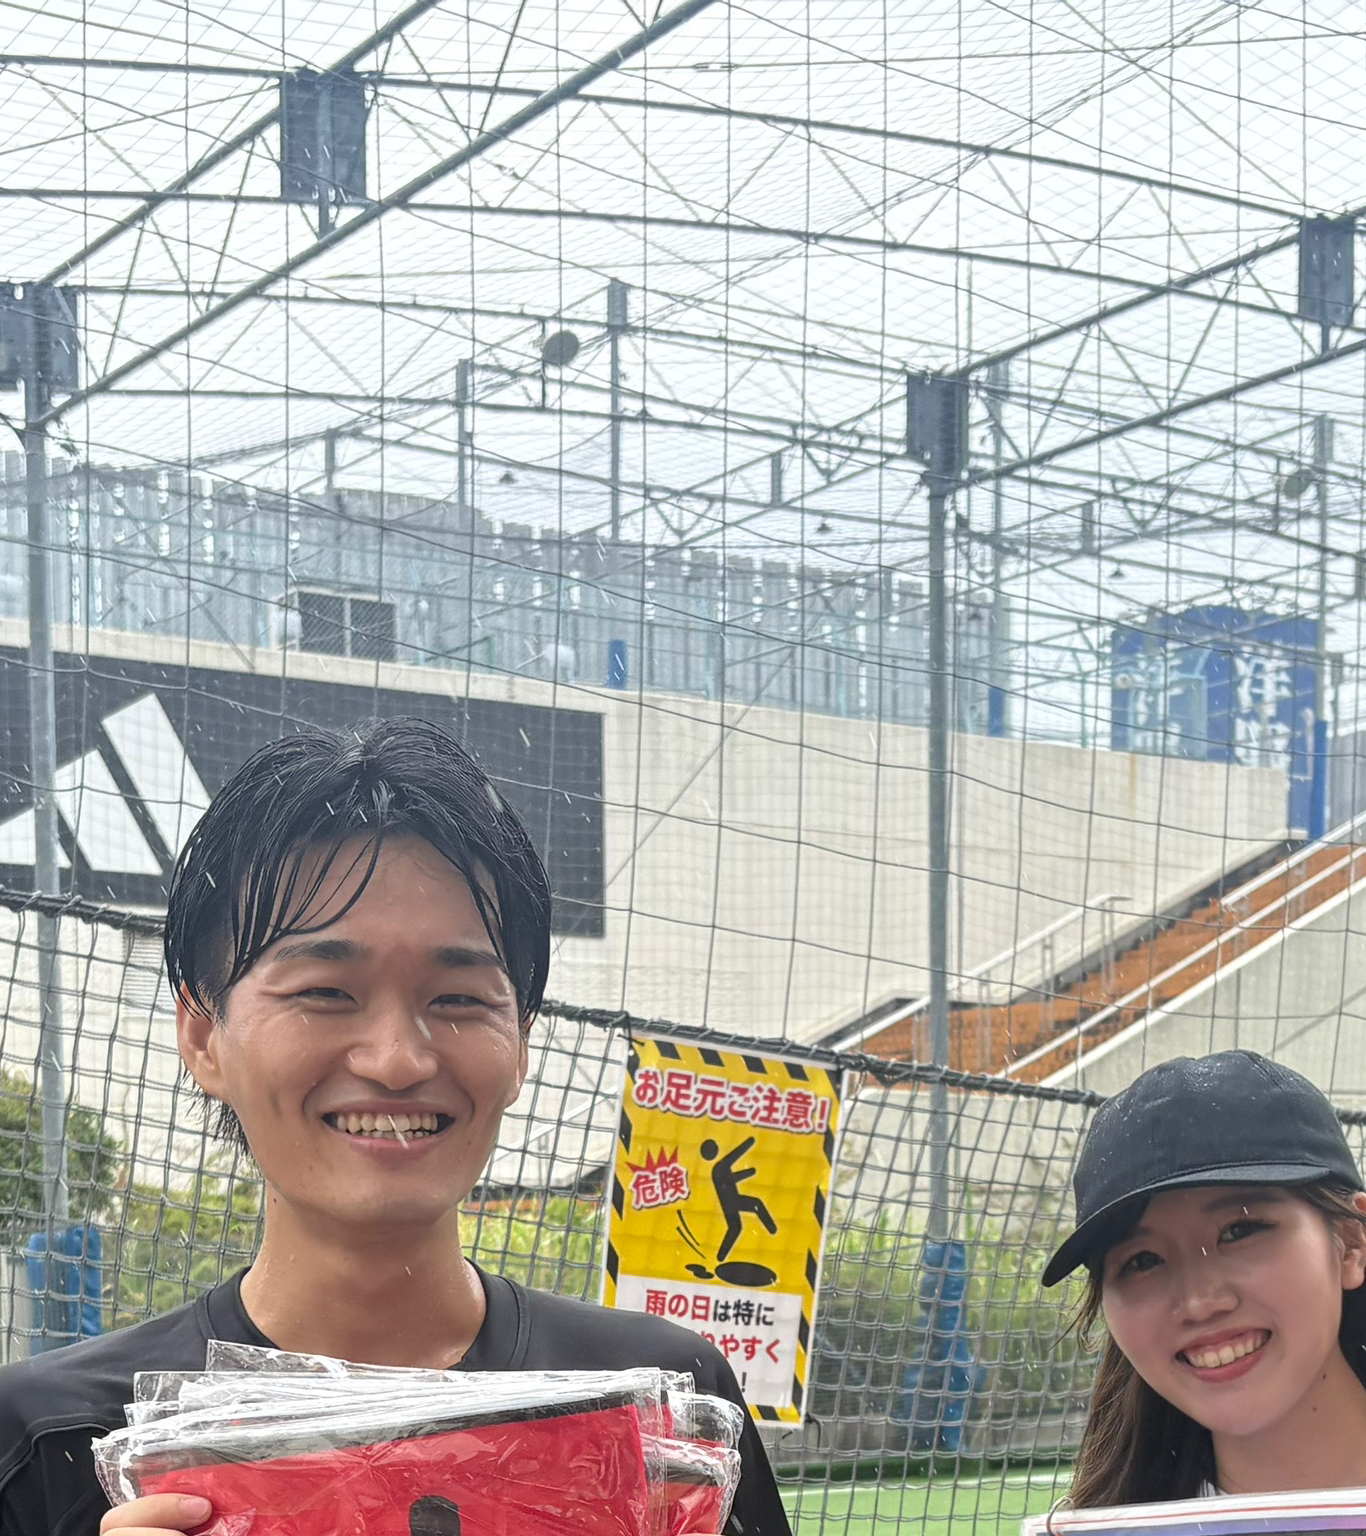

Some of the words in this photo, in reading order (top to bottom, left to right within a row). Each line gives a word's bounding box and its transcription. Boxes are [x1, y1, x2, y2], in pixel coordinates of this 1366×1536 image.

[635, 1069, 832, 1132] お足元ご注意!
[633, 1167, 687, 1206] 危険
[645, 1289, 775, 1327] 雨の日は特に
